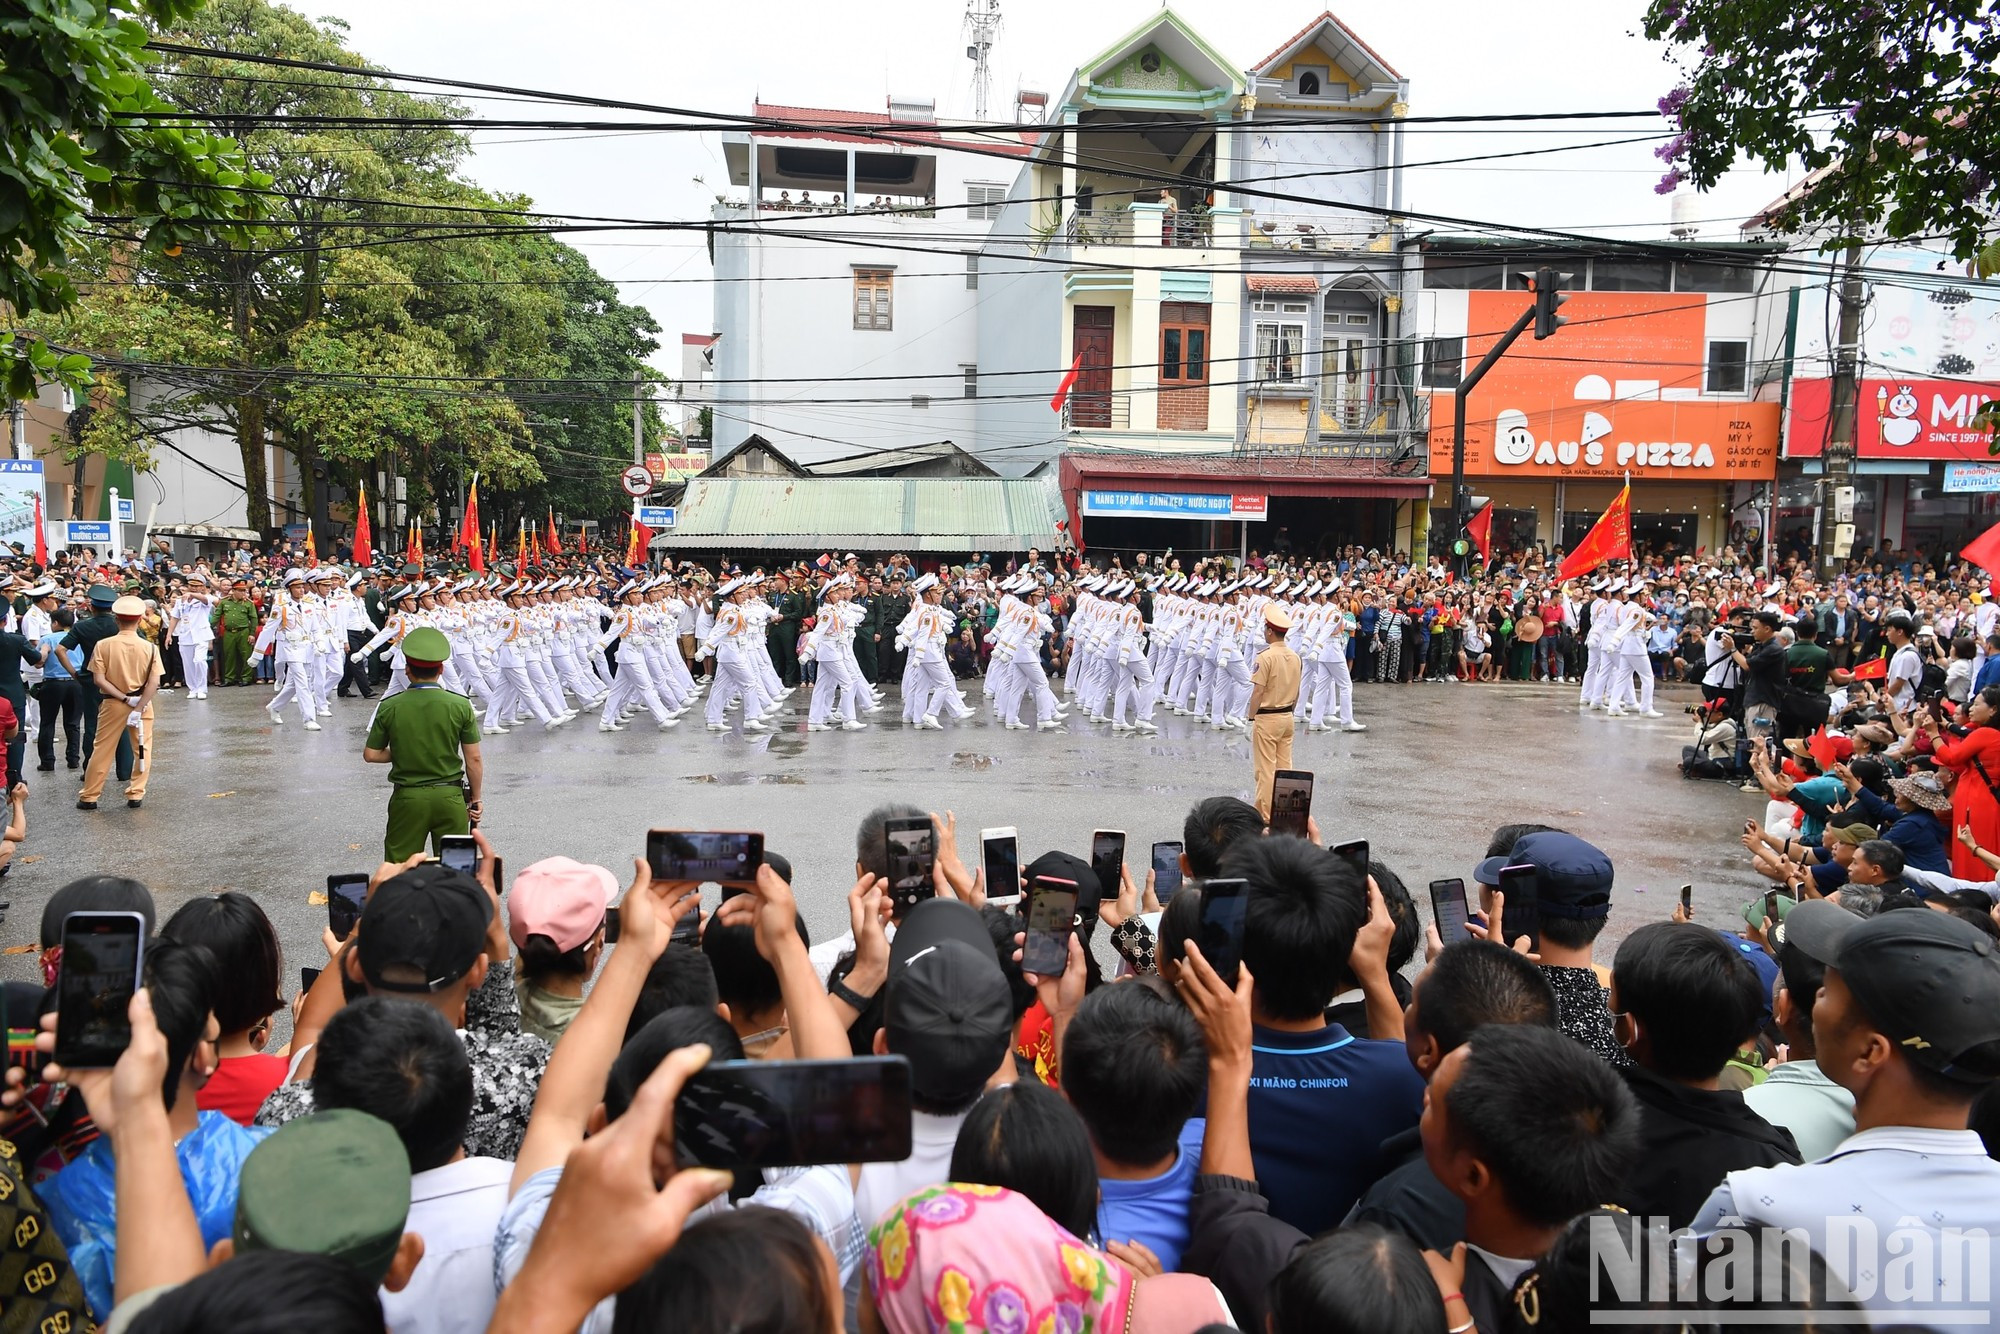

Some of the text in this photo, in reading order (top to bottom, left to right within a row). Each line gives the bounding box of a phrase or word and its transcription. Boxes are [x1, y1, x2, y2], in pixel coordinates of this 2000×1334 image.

[1729, 421, 1752, 429] PIZZA
[1929, 432, 1958, 442] SINCE
[1960, 433, 1979, 443] 1997
[1616, 441, 1715, 467] PIZZA
[11, 462, 33, 471] ÁN
[1095, 493, 1115, 505] HÀNG
[1116, 494, 1129, 507] TẠP
[1188, 496, 1207, 508] NƯỚC
[1208, 498, 1227, 510] NGỌT
[71, 531, 109, 540] TRƯỜNG CHINH
[1249, 1076, 1348, 1088] XI MĂNG CHINFON
